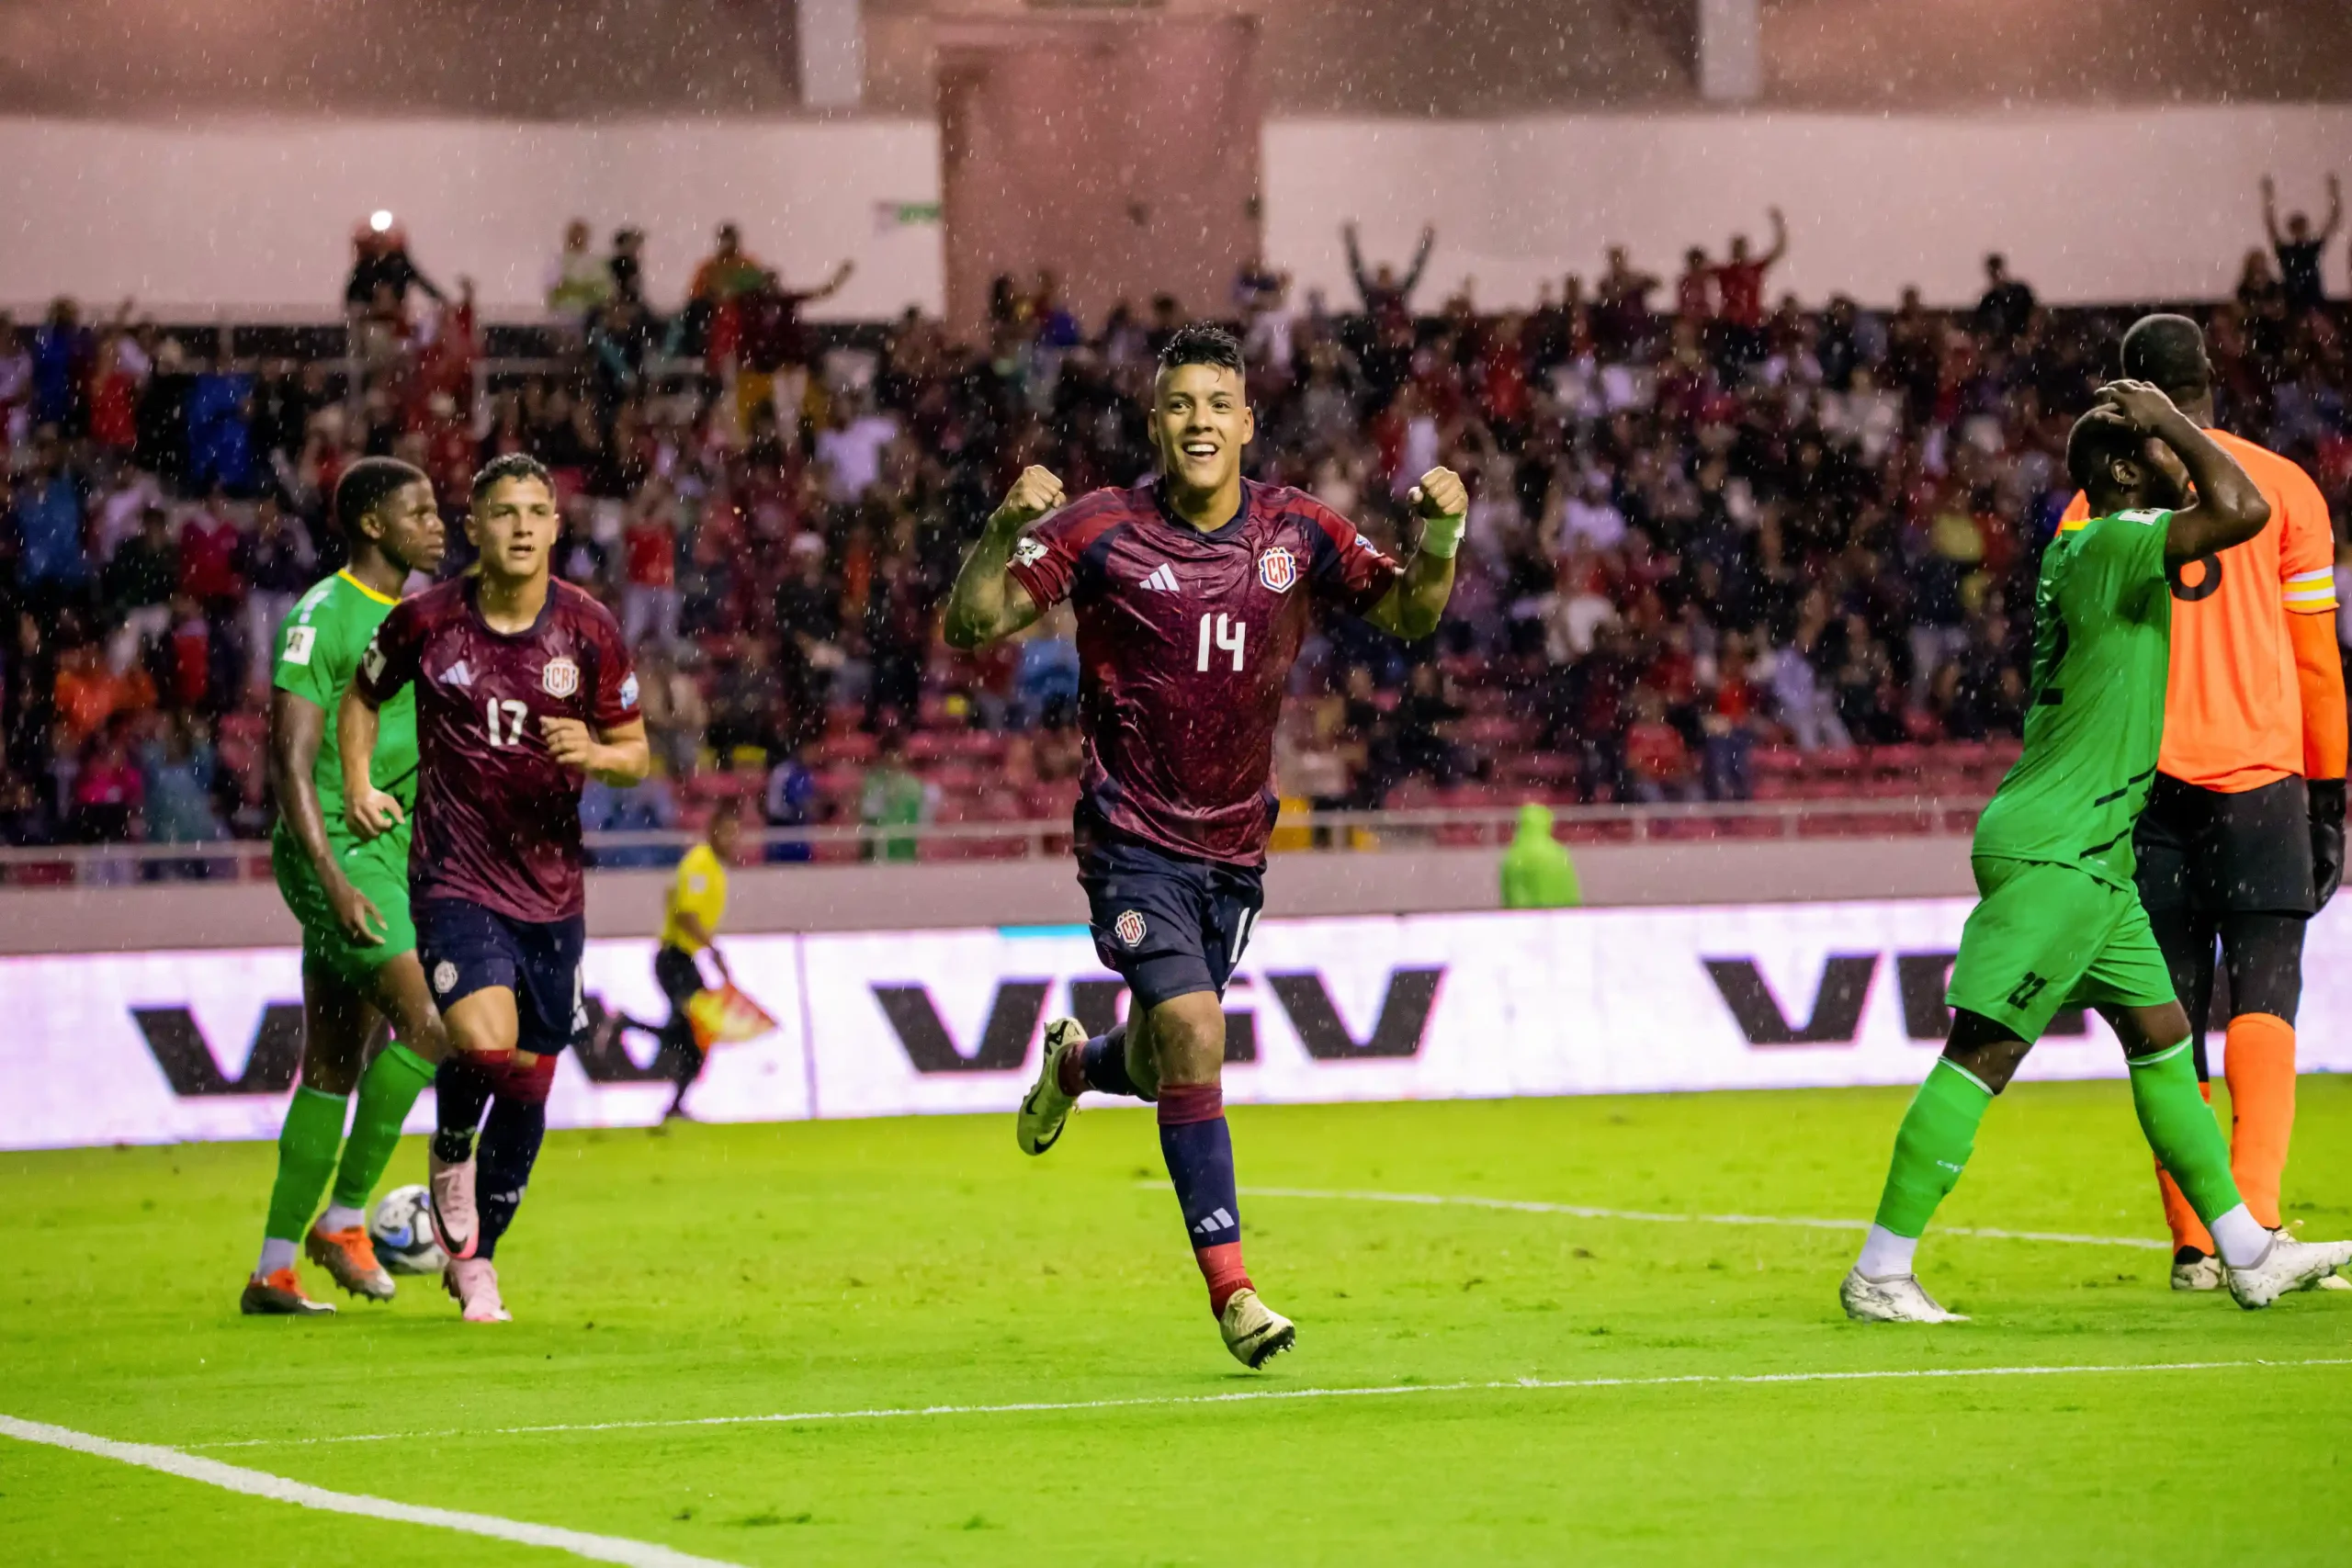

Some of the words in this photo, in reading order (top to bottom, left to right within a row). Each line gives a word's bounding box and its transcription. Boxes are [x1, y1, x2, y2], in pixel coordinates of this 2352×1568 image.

[1267, 555, 1288, 584] CR
[1197, 612, 1246, 671] 14
[552, 666, 570, 689] CR
[487, 697, 528, 747] 17
[1121, 917, 1141, 942] CR
[2007, 971, 2047, 1010] 22
